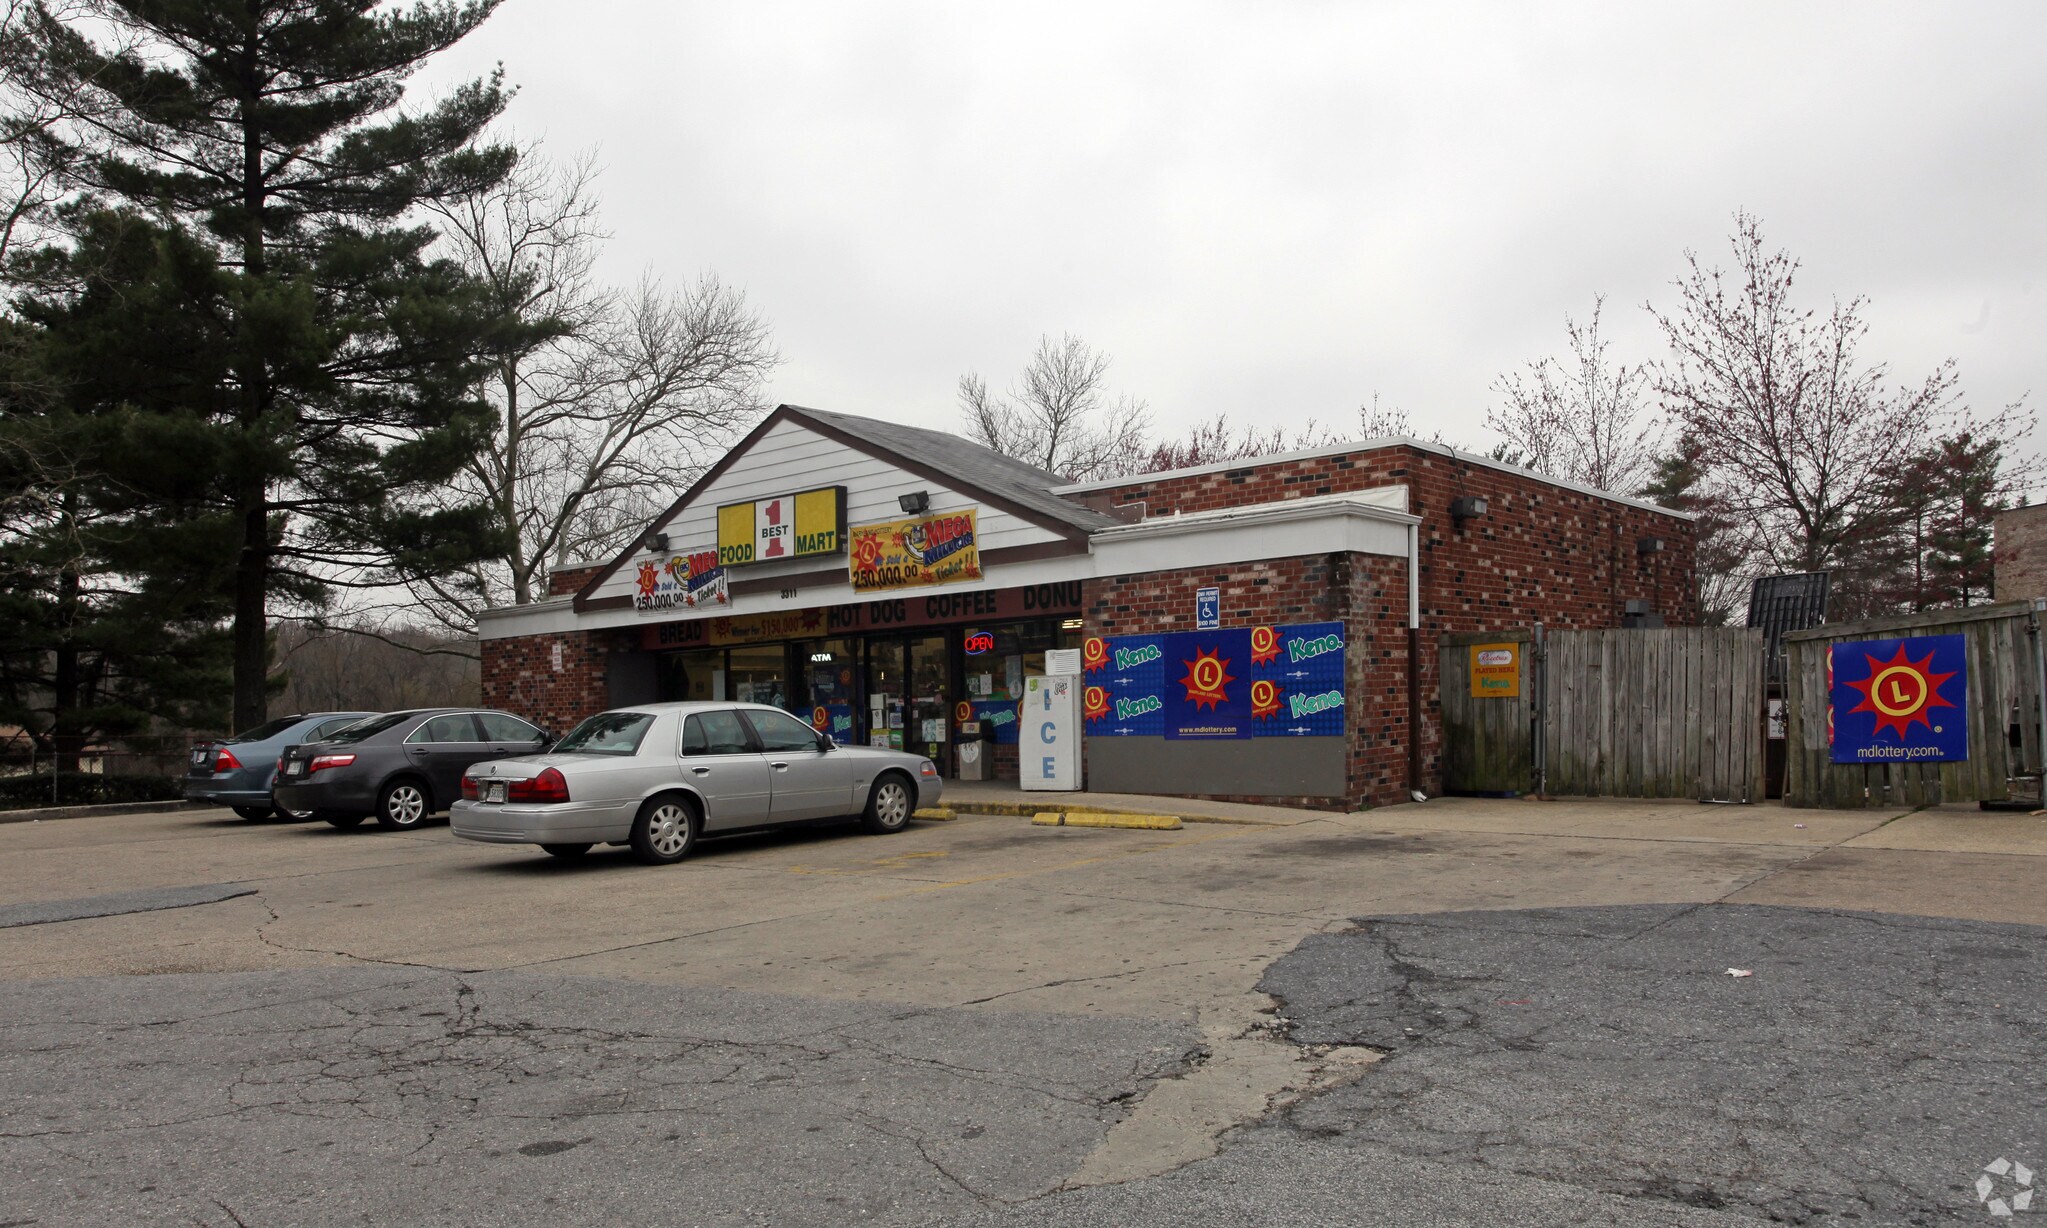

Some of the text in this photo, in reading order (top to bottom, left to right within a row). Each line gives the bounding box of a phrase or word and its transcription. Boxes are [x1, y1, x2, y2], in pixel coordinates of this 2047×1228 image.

[762, 525, 788, 538] BEST
[765, 500, 784, 557] 1
[923, 514, 973, 550] MEGA
[720, 543, 752, 563] FOOD
[797, 531, 834, 553] MART
[687, 551, 718, 579] MEG
[781, 589, 797, 599] 3311
[829, 604, 862, 628] HOT
[870, 600, 906, 624] DOG
[926, 590, 997, 618] COFFEE
[660, 621, 701, 644] BREAD
[964, 637, 994, 651] OPEN
[811, 653, 832, 662] ATM
